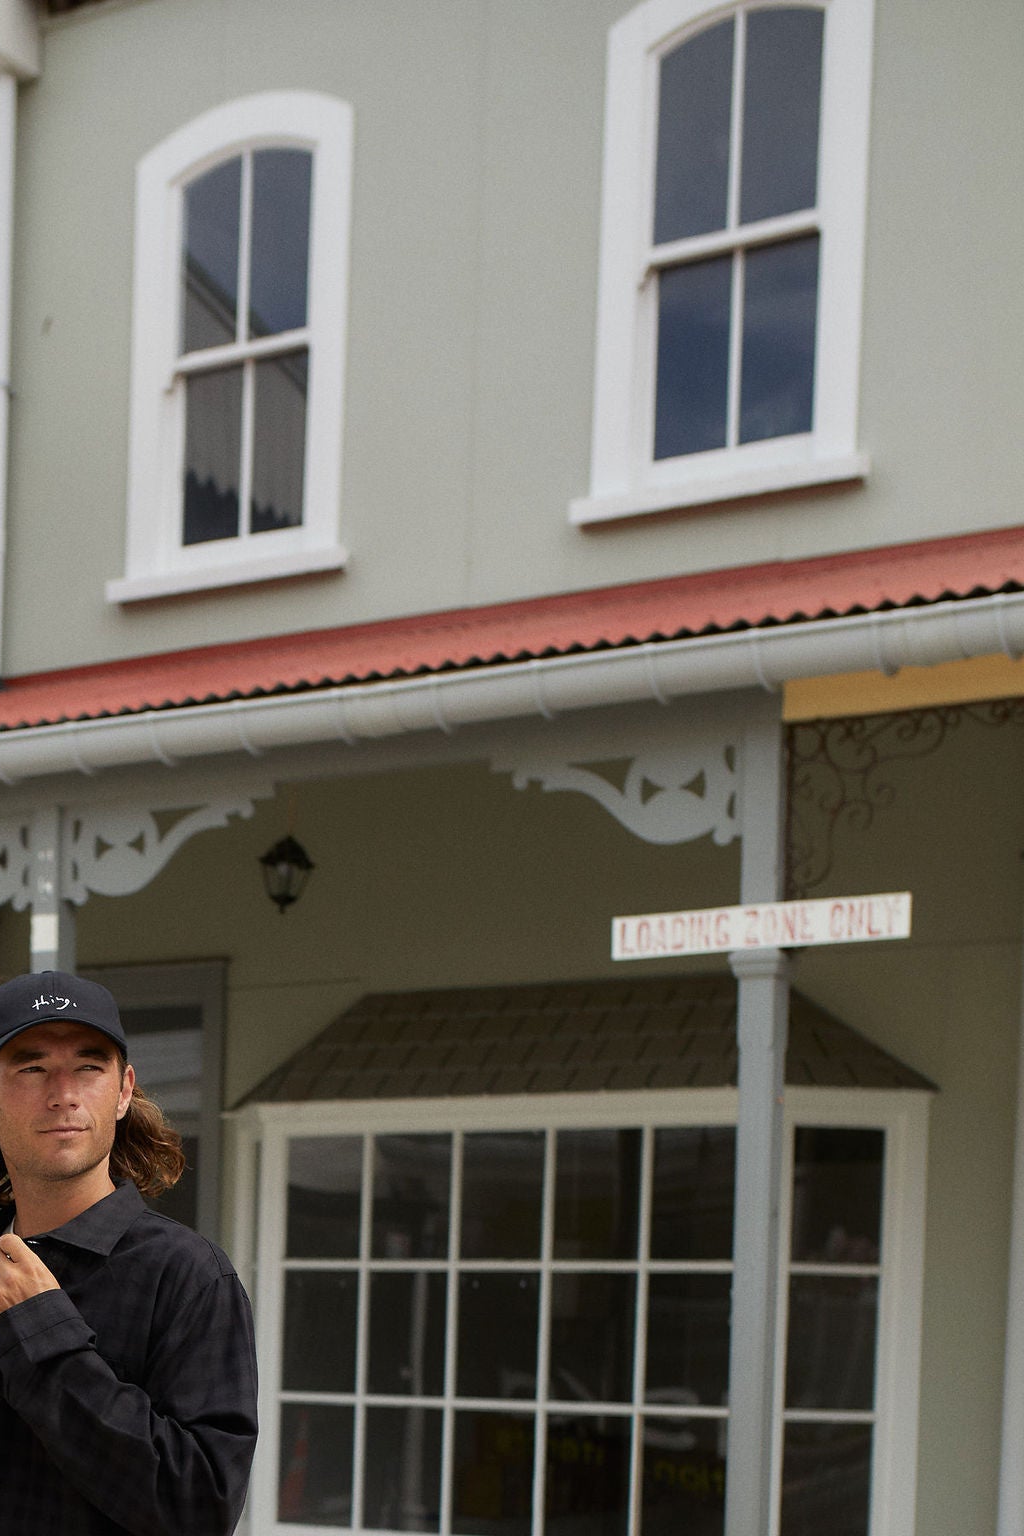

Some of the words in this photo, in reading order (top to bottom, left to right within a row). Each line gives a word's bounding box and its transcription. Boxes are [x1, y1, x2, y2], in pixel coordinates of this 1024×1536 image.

[619, 910, 730, 955] LOADING
[743, 904, 815, 946] ZONE
[829, 896, 903, 938] ONLY
